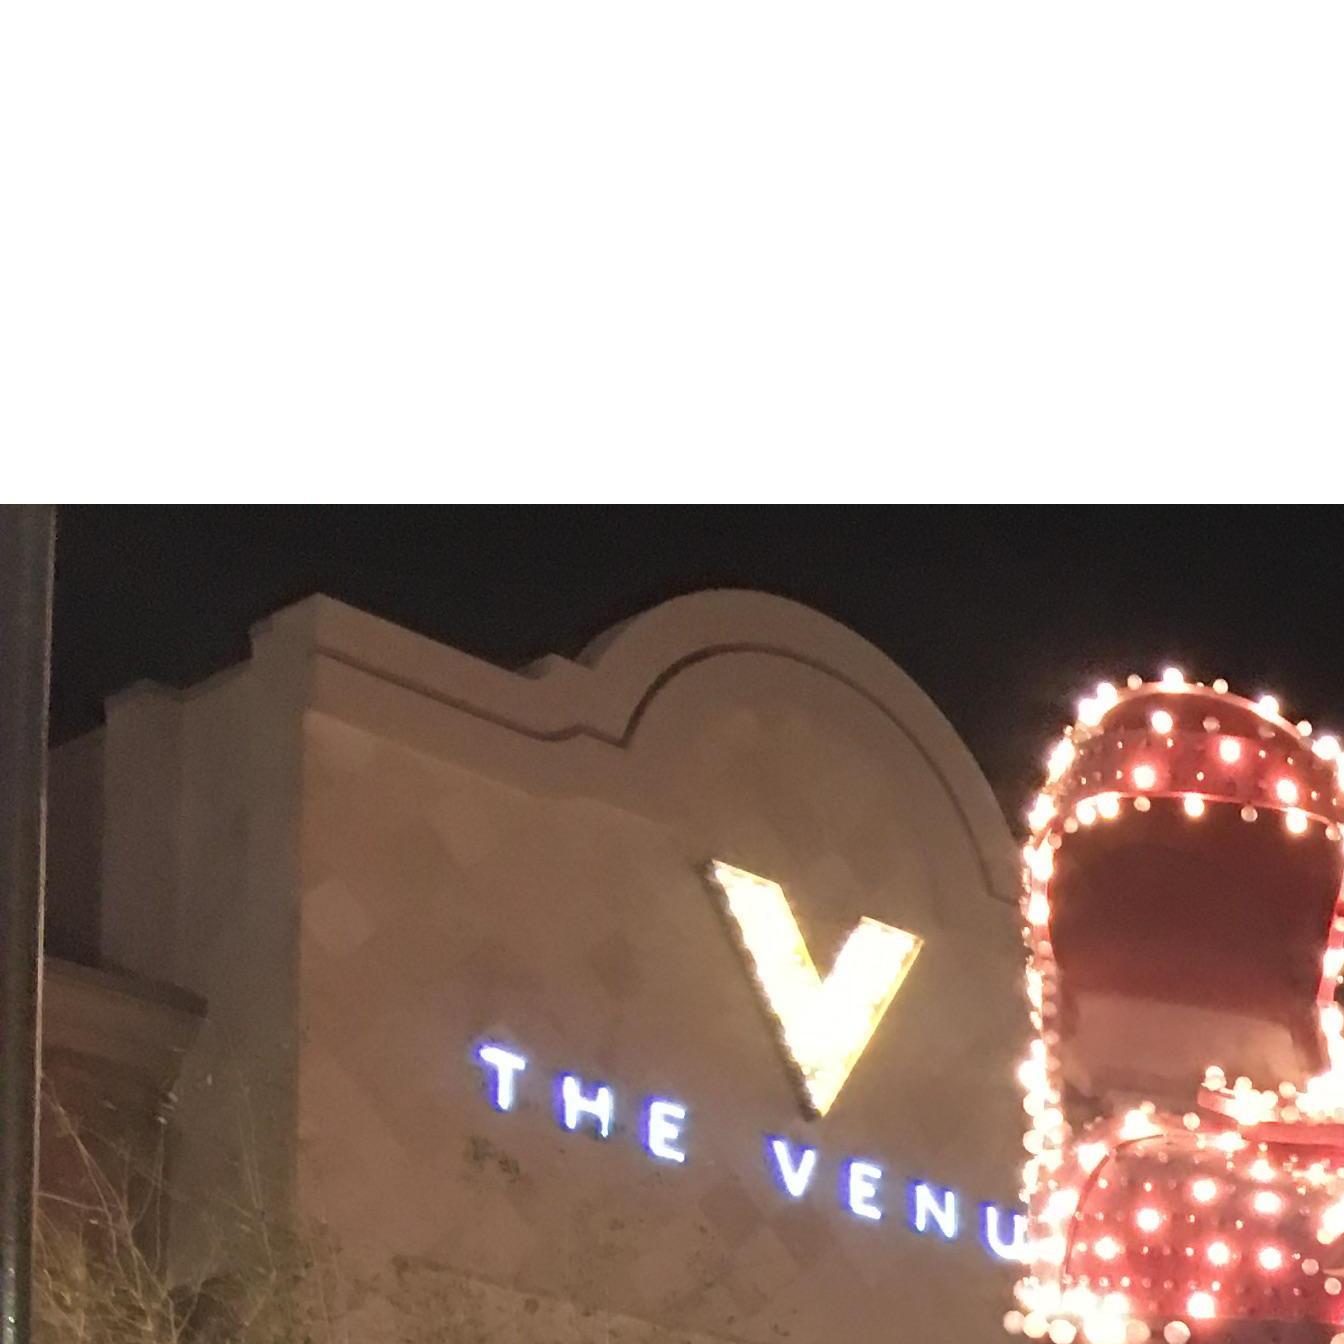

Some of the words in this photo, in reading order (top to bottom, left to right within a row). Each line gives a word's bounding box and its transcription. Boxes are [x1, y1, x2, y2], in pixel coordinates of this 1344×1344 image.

[708, 859, 924, 1119] V
[473, 1043, 687, 1163] THE
[765, 1136, 1030, 1262] VENU
